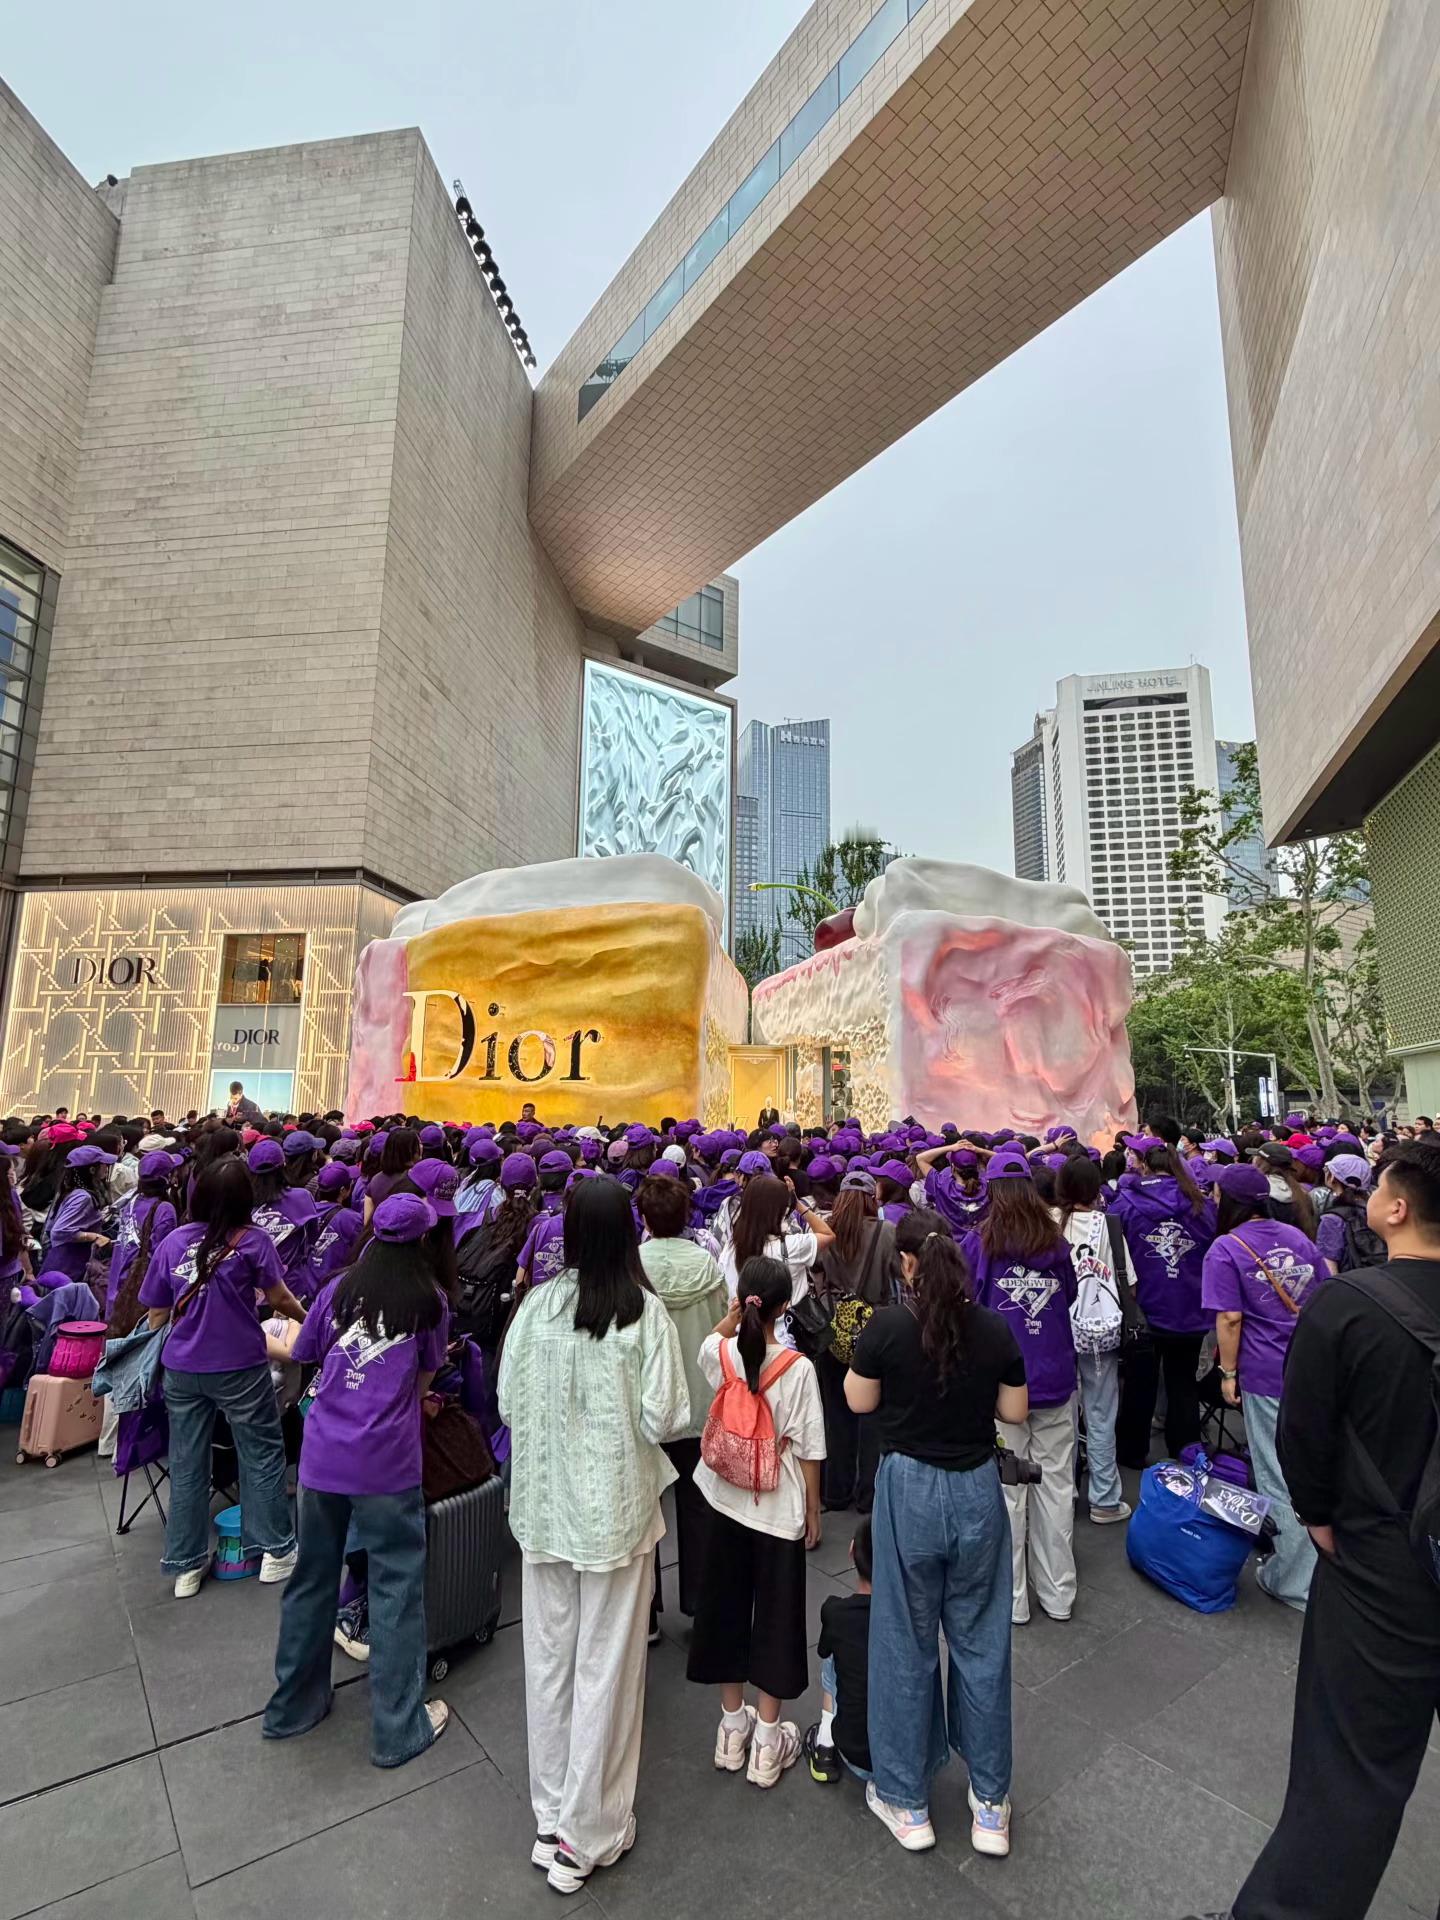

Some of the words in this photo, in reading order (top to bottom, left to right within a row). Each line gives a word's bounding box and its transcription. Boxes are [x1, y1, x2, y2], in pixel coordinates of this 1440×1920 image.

[71, 957, 157, 984] DIOR
[233, 1028, 280, 1045] DIOR
[395, 990, 602, 1082] Dior
